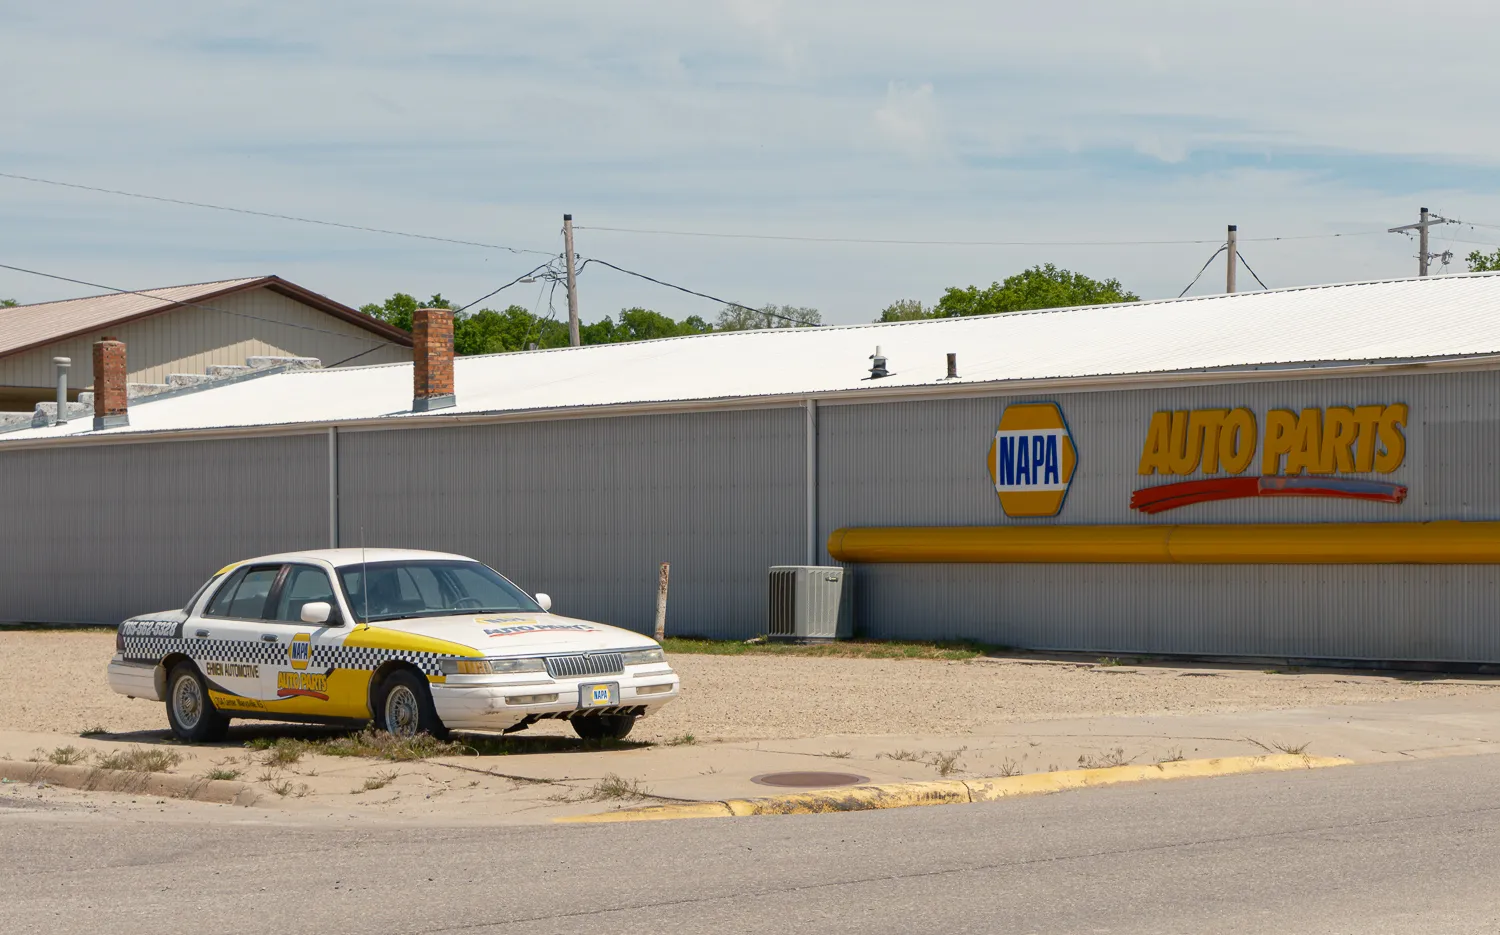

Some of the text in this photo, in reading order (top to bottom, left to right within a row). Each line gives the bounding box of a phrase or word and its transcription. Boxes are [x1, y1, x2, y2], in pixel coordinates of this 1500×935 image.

[1138, 402, 1408, 476] AUTO PARTS
[1000, 434, 1059, 485] NAPA
[122, 621, 178, 637] 785-562-5328
[483, 625, 534, 635] AUTO
[292, 642, 309, 660] NAPA
[225, 663, 259, 678] AUTOMOTIVE
[277, 671, 327, 692] AUTO PARTS
[593, 690, 607, 700] NAPA
